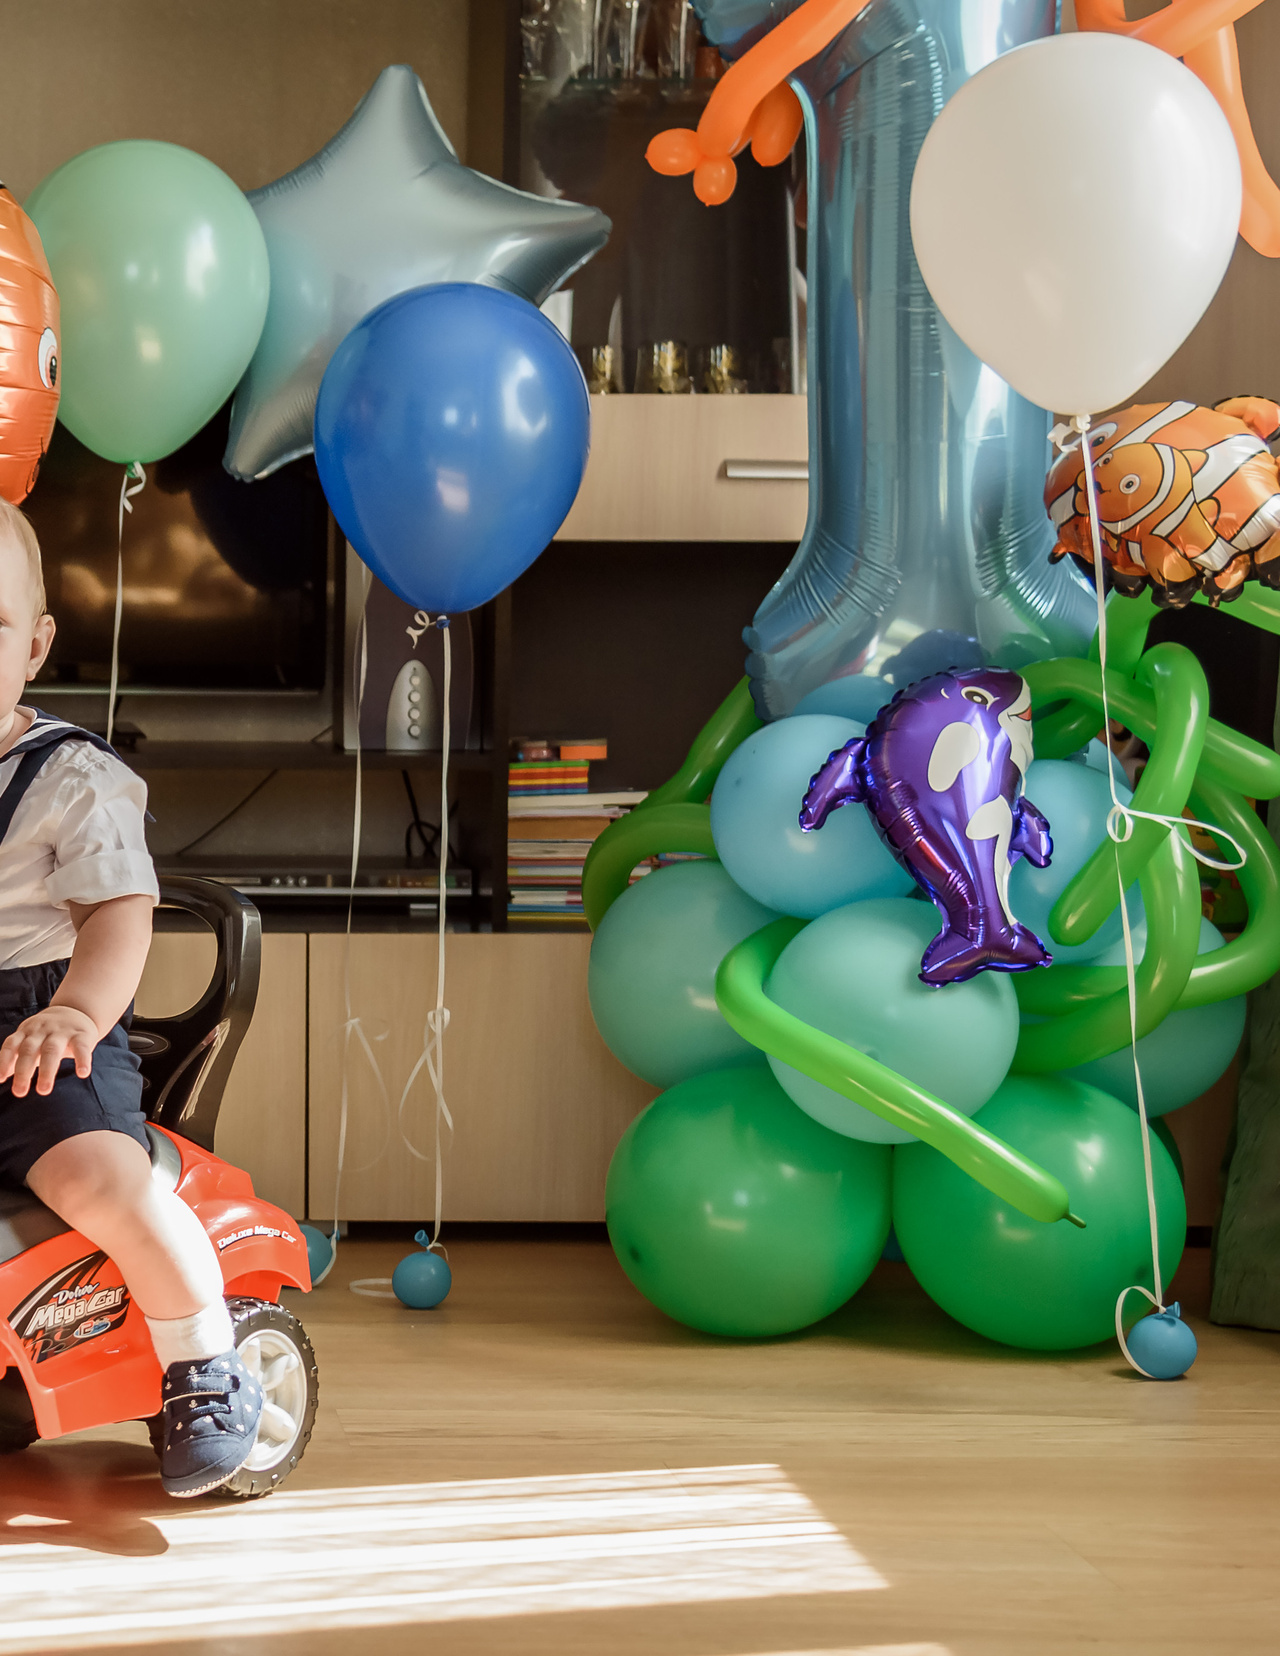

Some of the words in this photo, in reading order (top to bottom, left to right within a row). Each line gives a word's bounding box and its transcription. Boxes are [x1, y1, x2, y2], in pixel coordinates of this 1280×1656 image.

[217, 1228, 253, 1249] Deluxe
[254, 1225, 280, 1237] Mega
[282, 1231, 297, 1243] Car
[23, 1299, 87, 1337] Mega
[87, 1286, 125, 1315] Car
